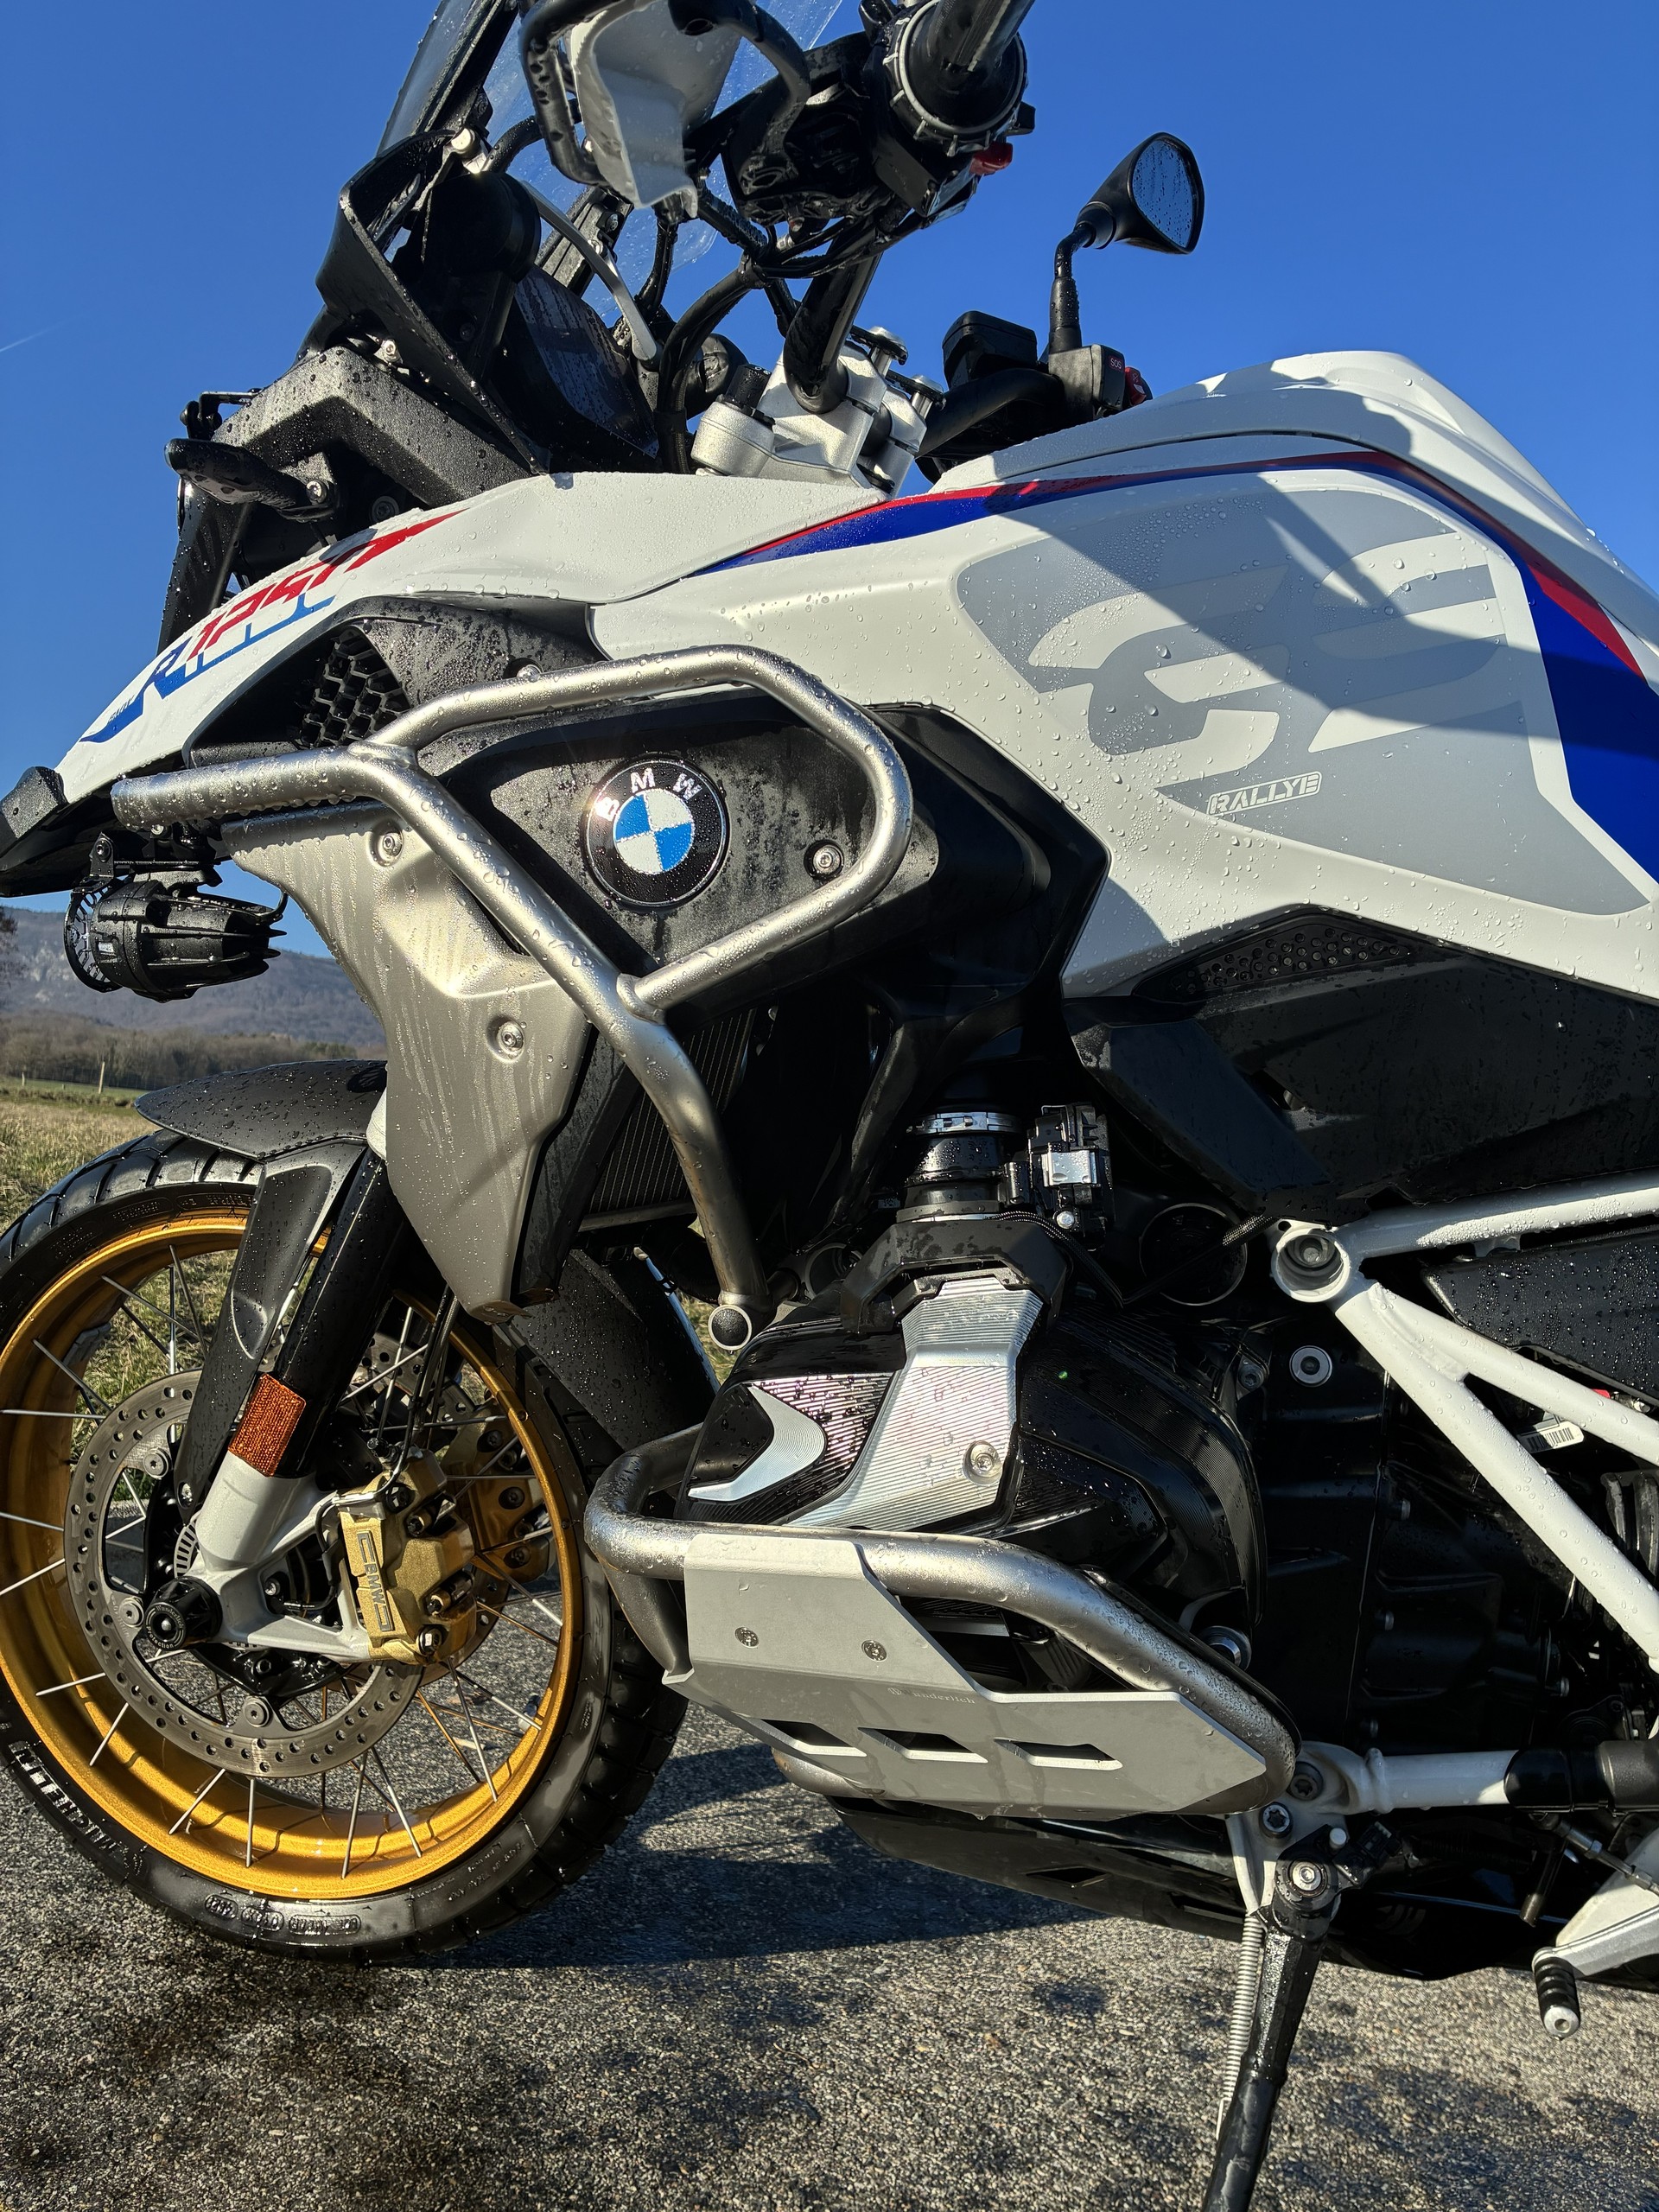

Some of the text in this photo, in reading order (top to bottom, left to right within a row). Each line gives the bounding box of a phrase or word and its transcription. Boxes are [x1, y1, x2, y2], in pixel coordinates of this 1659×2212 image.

[1110, 358, 1122, 370] SOS
[594, 767, 703, 821] BMW
[1210, 773, 1319, 814] RALLYE
[363, 1562, 386, 1605] BMW
[146, 1625, 175, 1649] Protection
[13, 1748, 118, 1853] MICHELIN
